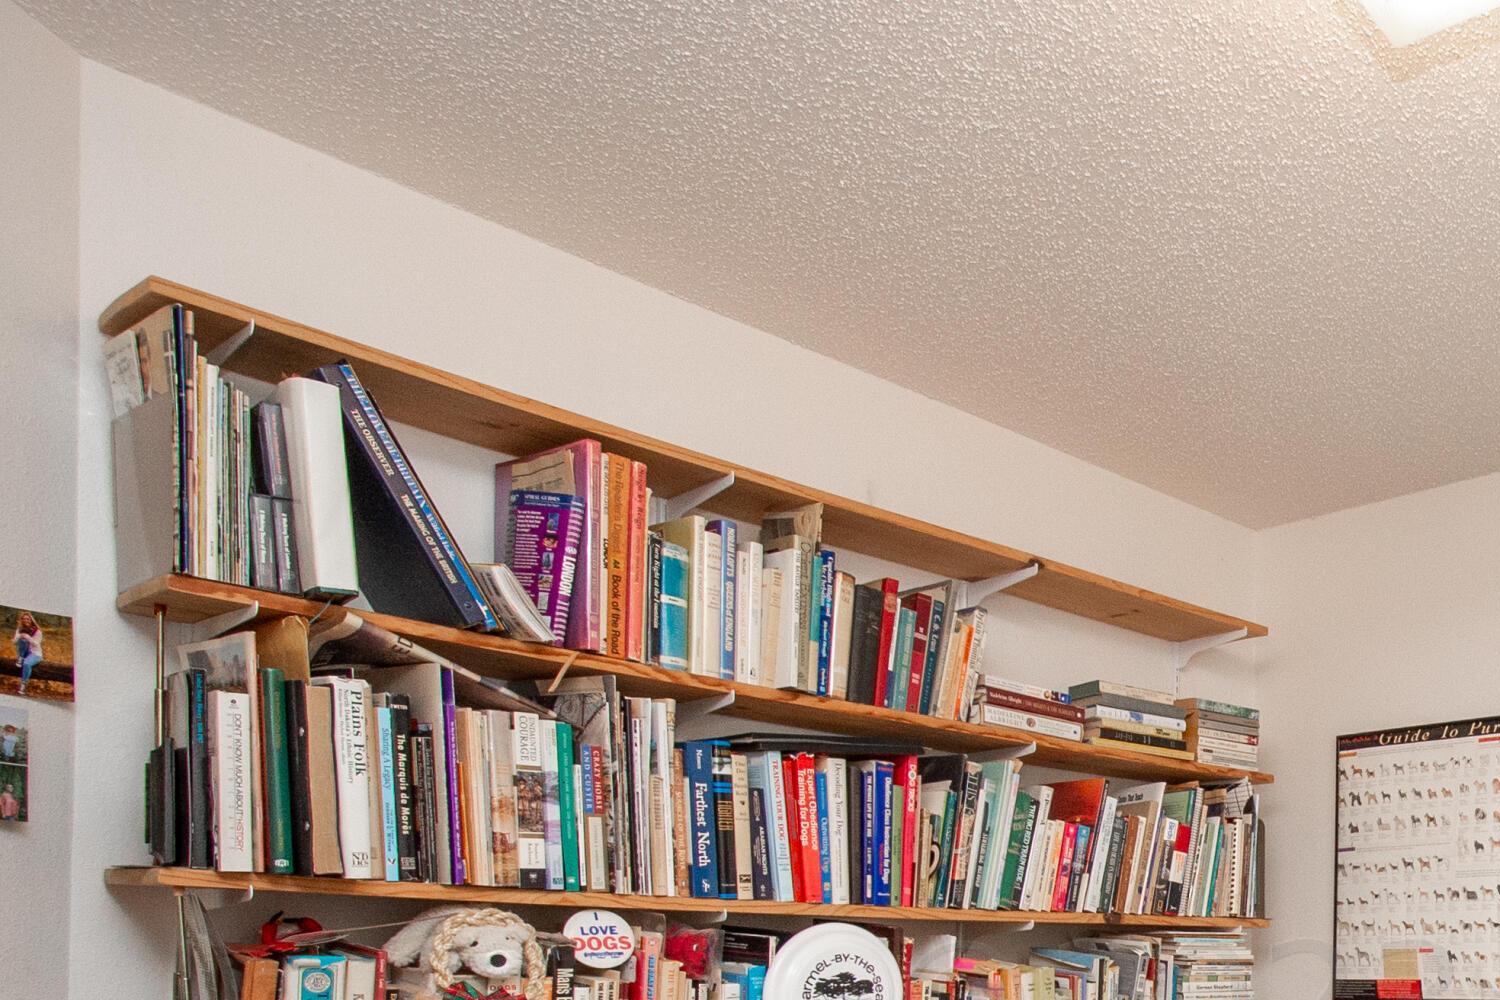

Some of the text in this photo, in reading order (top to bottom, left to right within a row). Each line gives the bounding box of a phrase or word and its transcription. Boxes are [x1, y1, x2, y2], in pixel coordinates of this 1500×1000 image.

[557, 555, 577, 595] LONDON
[349, 690, 367, 776] Plains Folk
[380, 727, 390, 757] Sharing
[396, 733, 406, 750] The
[517, 714, 528, 760] COURAGE
[528, 716, 537, 761] UNDAUNTED
[1378, 728, 1430, 747] Guide
[1440, 722, 1460, 738] To
[234, 713, 244, 851] DON'T KNOW MUCH ABOUT HISTORY
[381, 764, 391, 790] Legacy
[396, 752, 408, 790] Marquis
[582, 749, 592, 809] AND CUSTER
[591, 750, 603, 810] CRAZY HORSE
[399, 791, 409, 804] de
[795, 768, 810, 846] Training for Dogs
[805, 767, 820, 849] Expert Obedience
[694, 781, 711, 867] Farthest North
[882, 825, 890, 858] Instruction
[881, 867, 889, 884] Dogs
[574, 936, 632, 950] DOGS
[580, 926, 618, 936] LOVE
[555, 967, 573, 995] Man's
